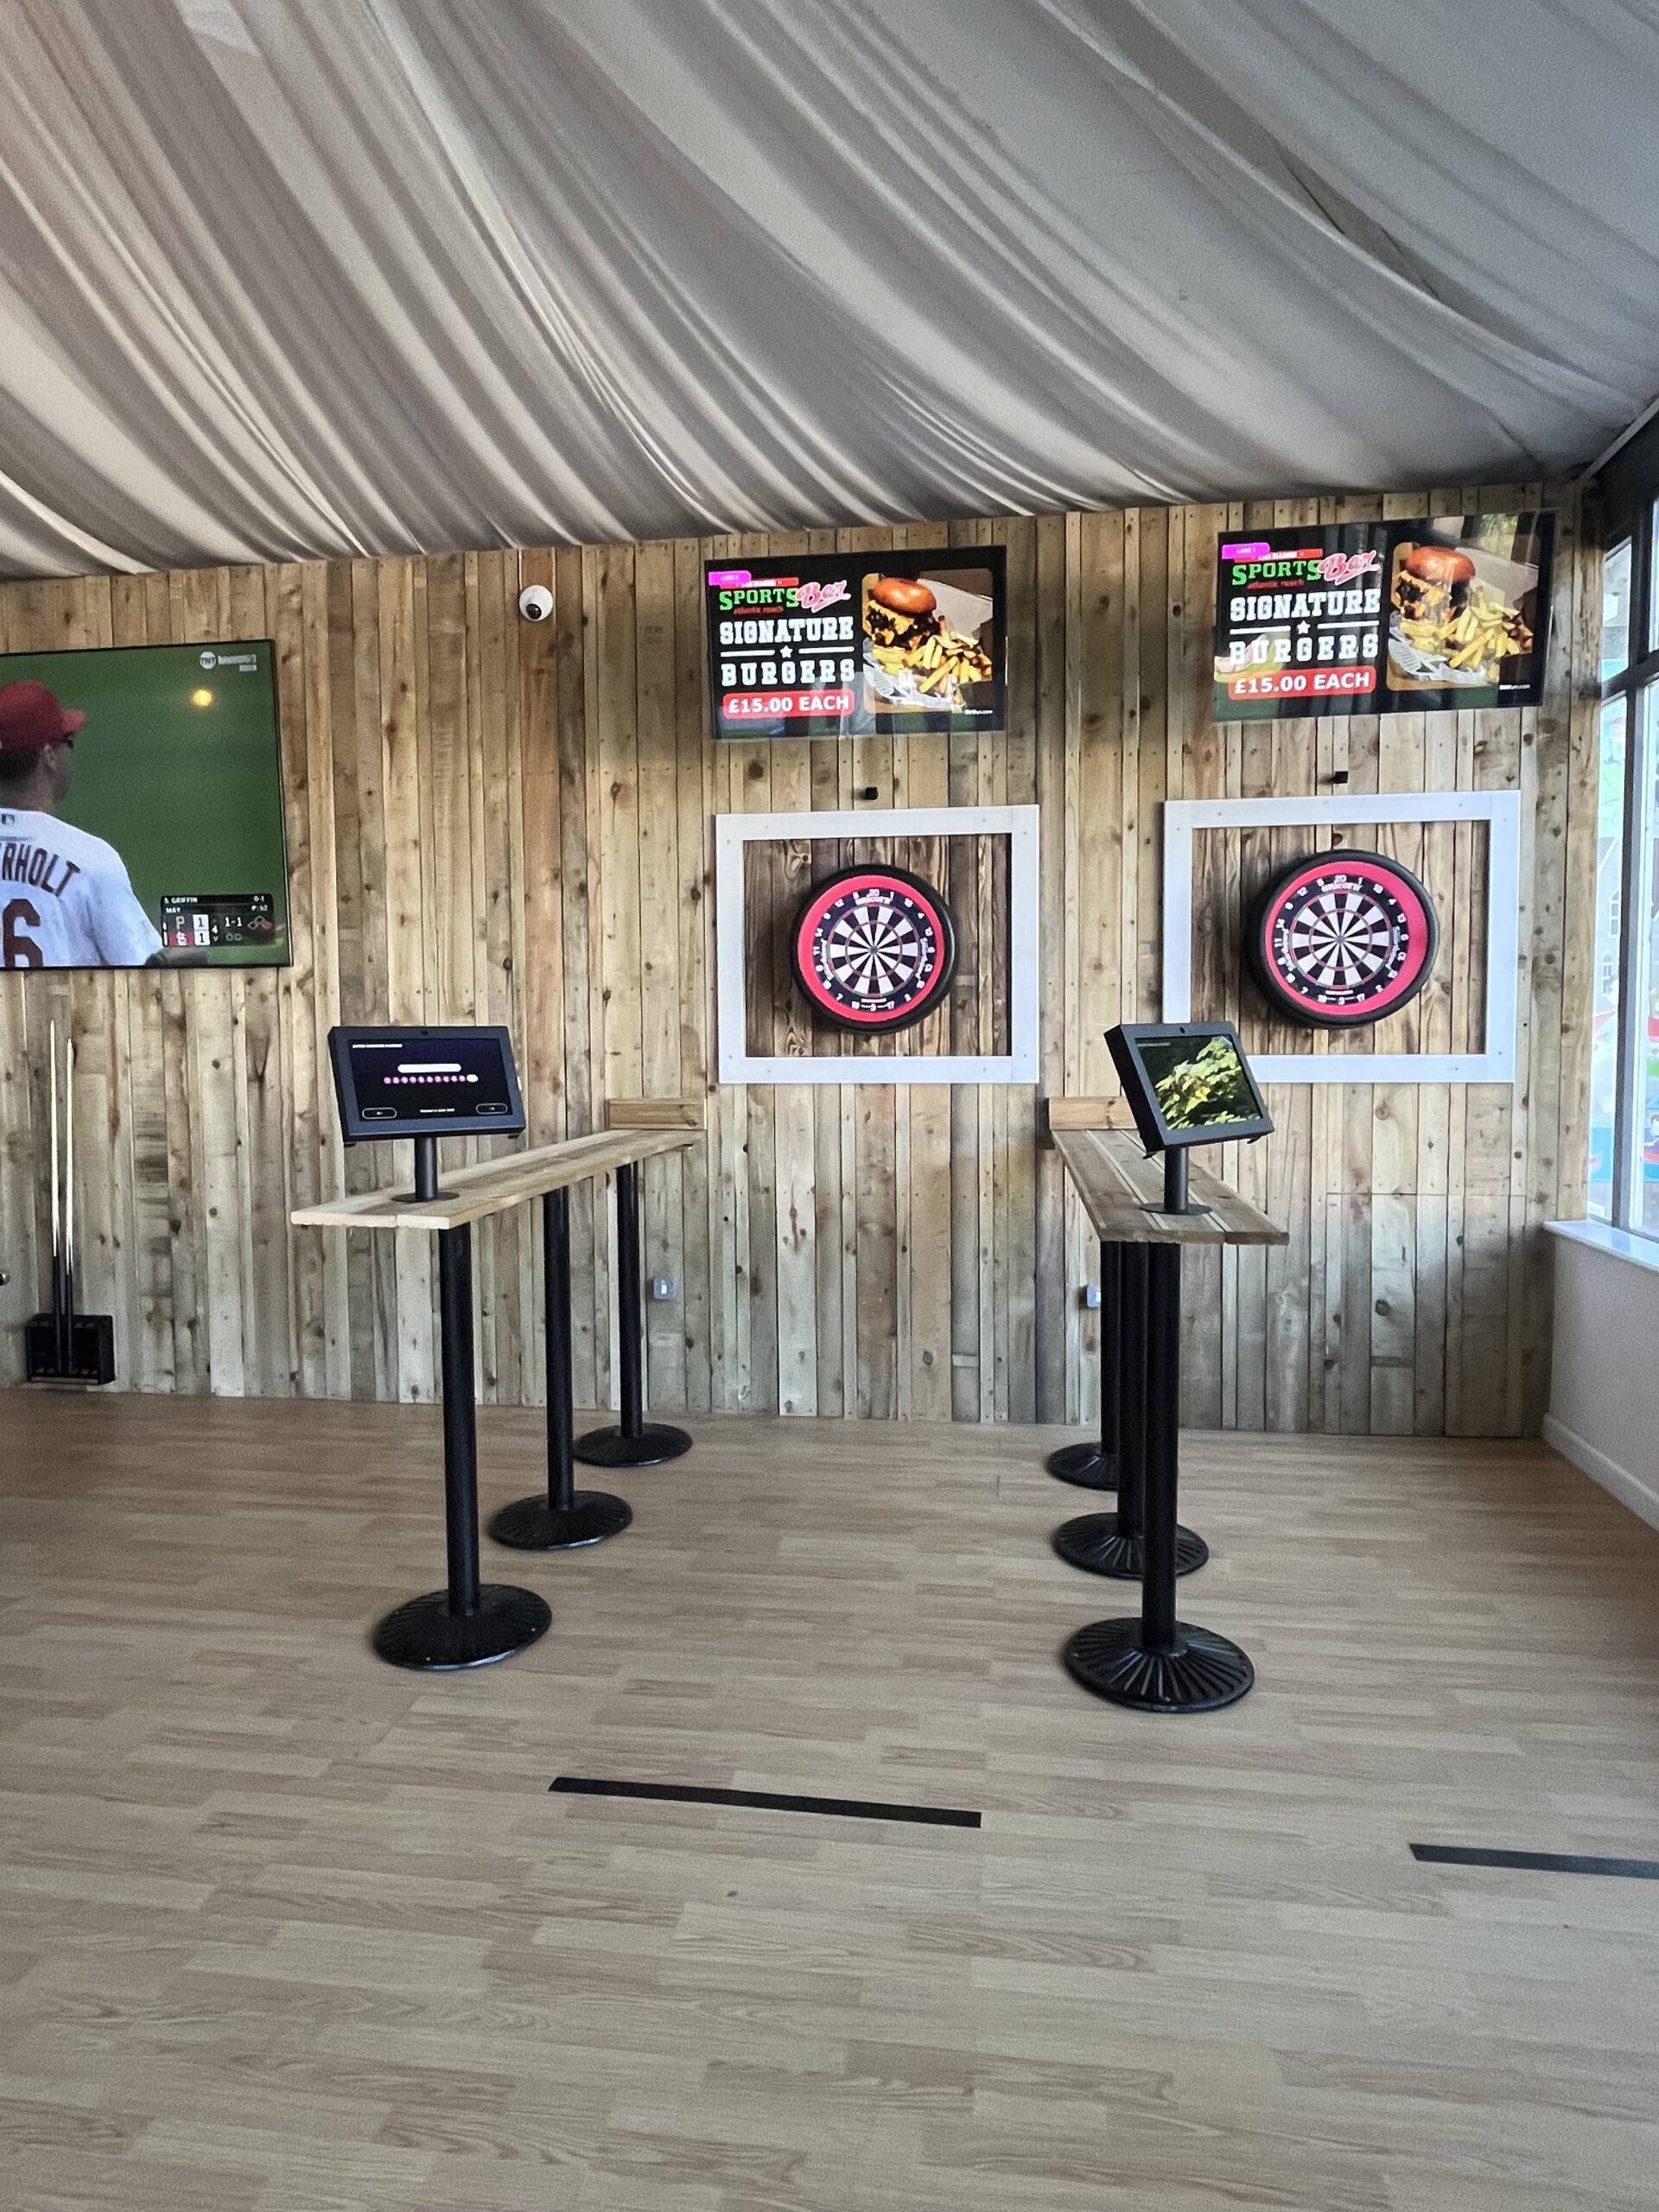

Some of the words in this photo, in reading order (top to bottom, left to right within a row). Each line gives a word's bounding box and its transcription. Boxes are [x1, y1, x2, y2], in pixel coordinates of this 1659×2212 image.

[1232, 560, 1323, 585] SPORTS
[1317, 550, 1381, 586] Bar
[719, 588, 799, 610] SPORTS
[795, 580, 851, 613] Bar
[1230, 588, 1382, 622] SIGNATURE
[719, 616, 854, 645] SIGNATURE
[1229, 633, 1378, 664] BURGERS
[721, 658, 855, 687] BURGERS
[1234, 674, 1306, 694] £15.00
[1313, 671, 1370, 690] EACH
[728, 696, 793, 714] £15.00
[799, 696, 849, 712] EACH
[0, 842, 81, 897] RHOLT
[868, 888, 880, 897] 20
[3, 899, 43, 968] 6
[225, 917, 242, 927] 1-1
